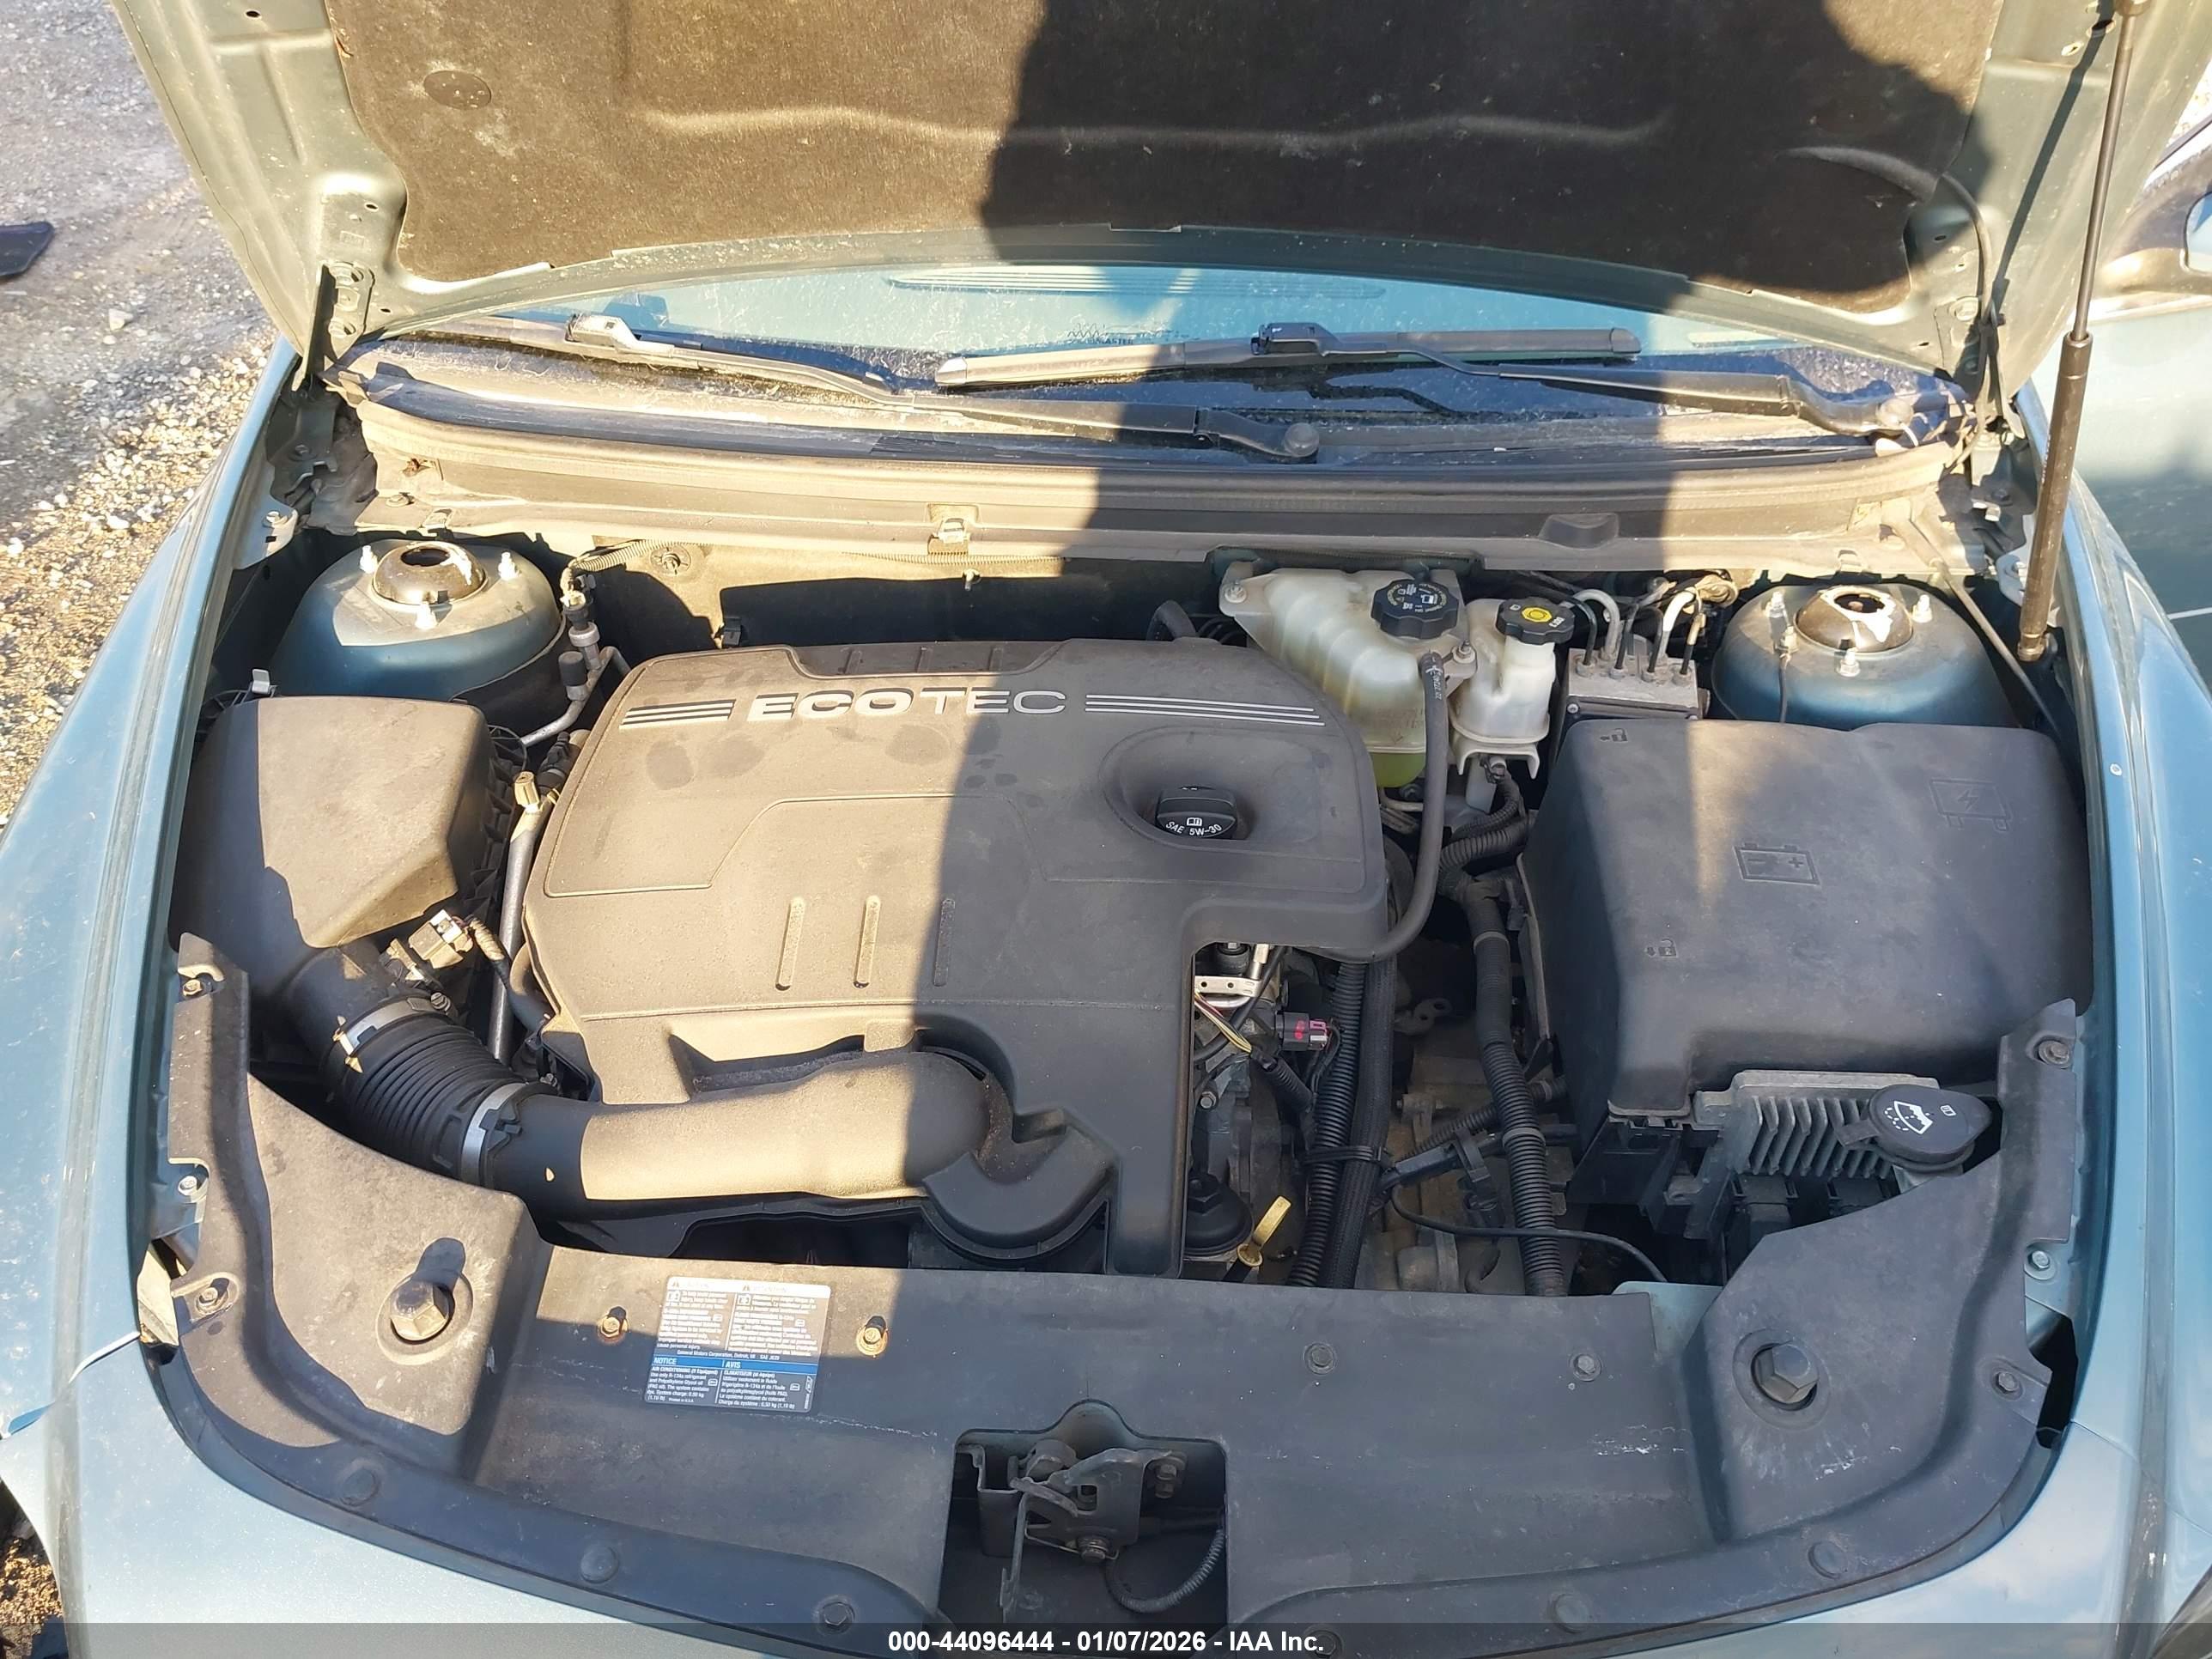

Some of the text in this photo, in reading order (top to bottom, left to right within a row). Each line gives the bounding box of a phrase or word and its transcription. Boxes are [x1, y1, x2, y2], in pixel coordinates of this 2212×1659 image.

[747, 688, 1066, 722] ECOTEC
[1165, 821, 1222, 836] SAE 5W-30
